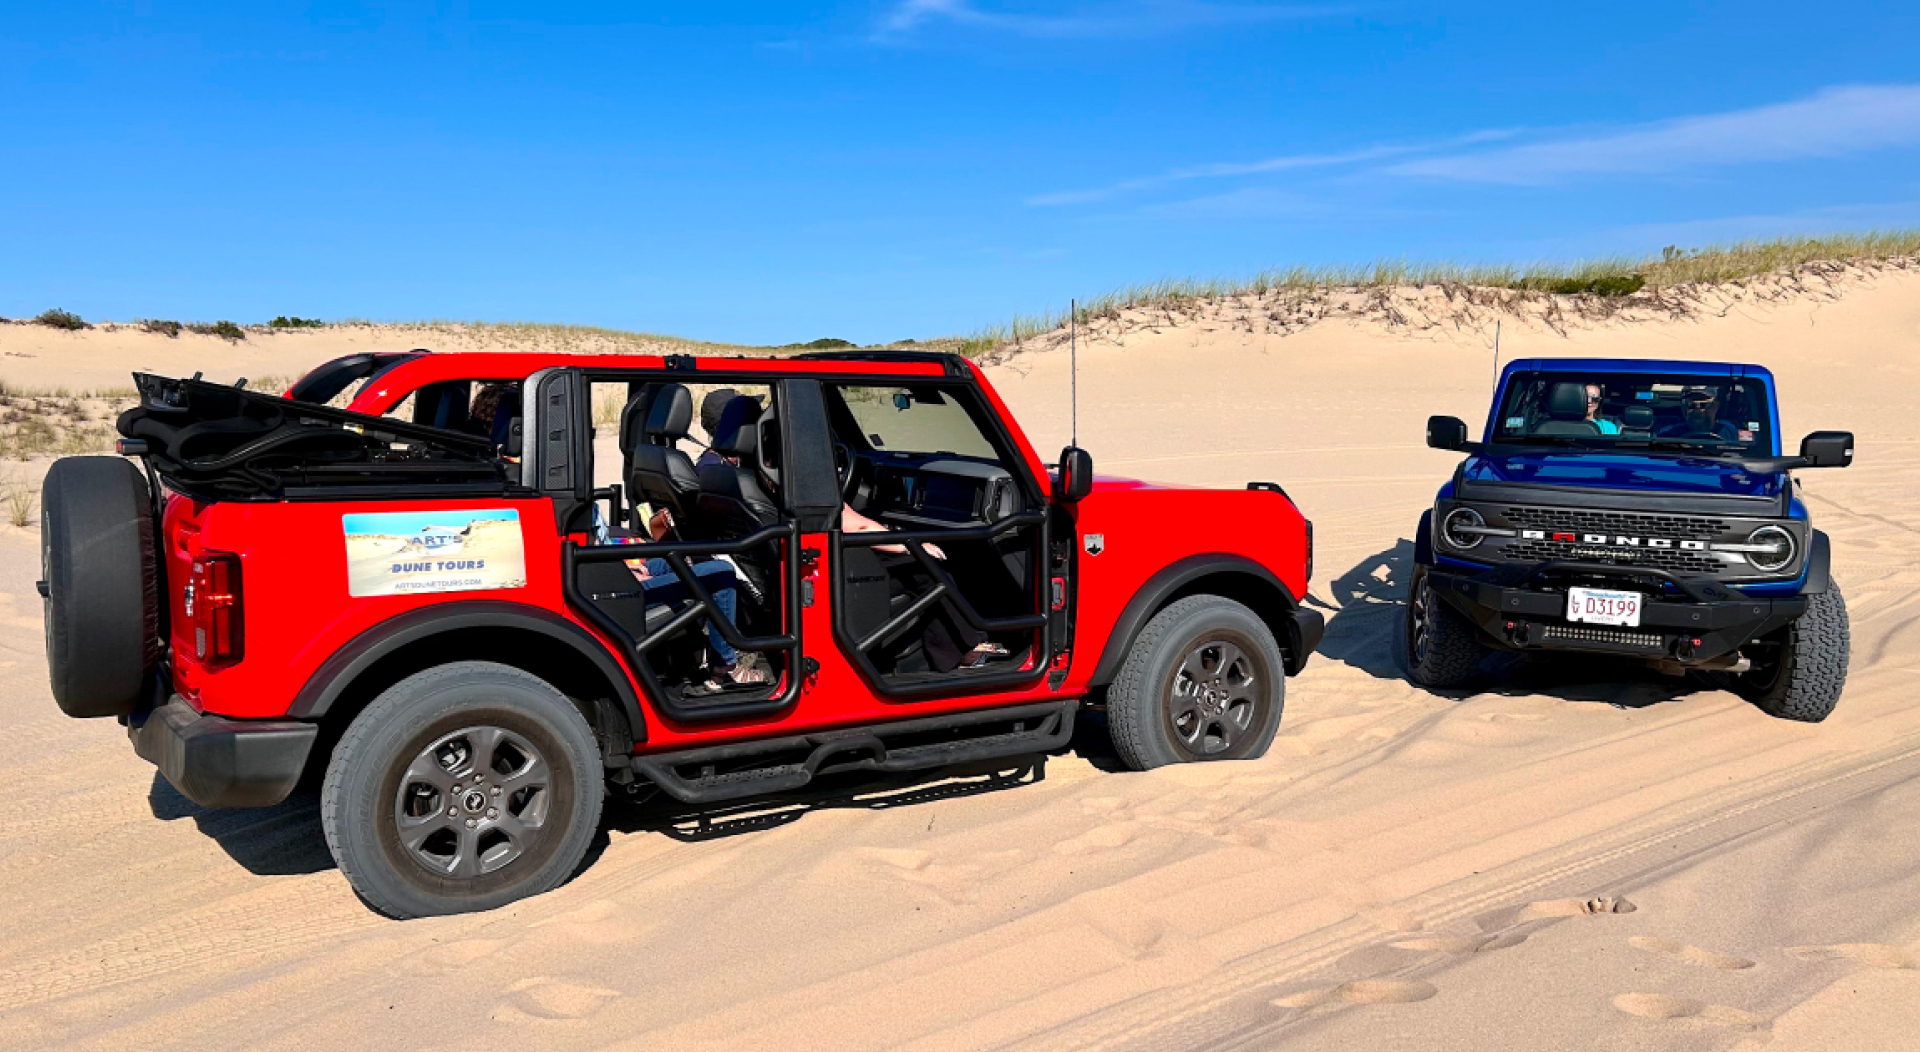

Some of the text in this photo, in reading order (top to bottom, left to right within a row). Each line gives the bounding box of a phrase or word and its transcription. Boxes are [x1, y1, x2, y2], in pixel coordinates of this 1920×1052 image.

[411, 535, 463, 545] ART'S
[1522, 530, 1705, 550] BRONCO
[391, 559, 485, 573] DUNE TOURS
[1585, 597, 1637, 617] D3199
